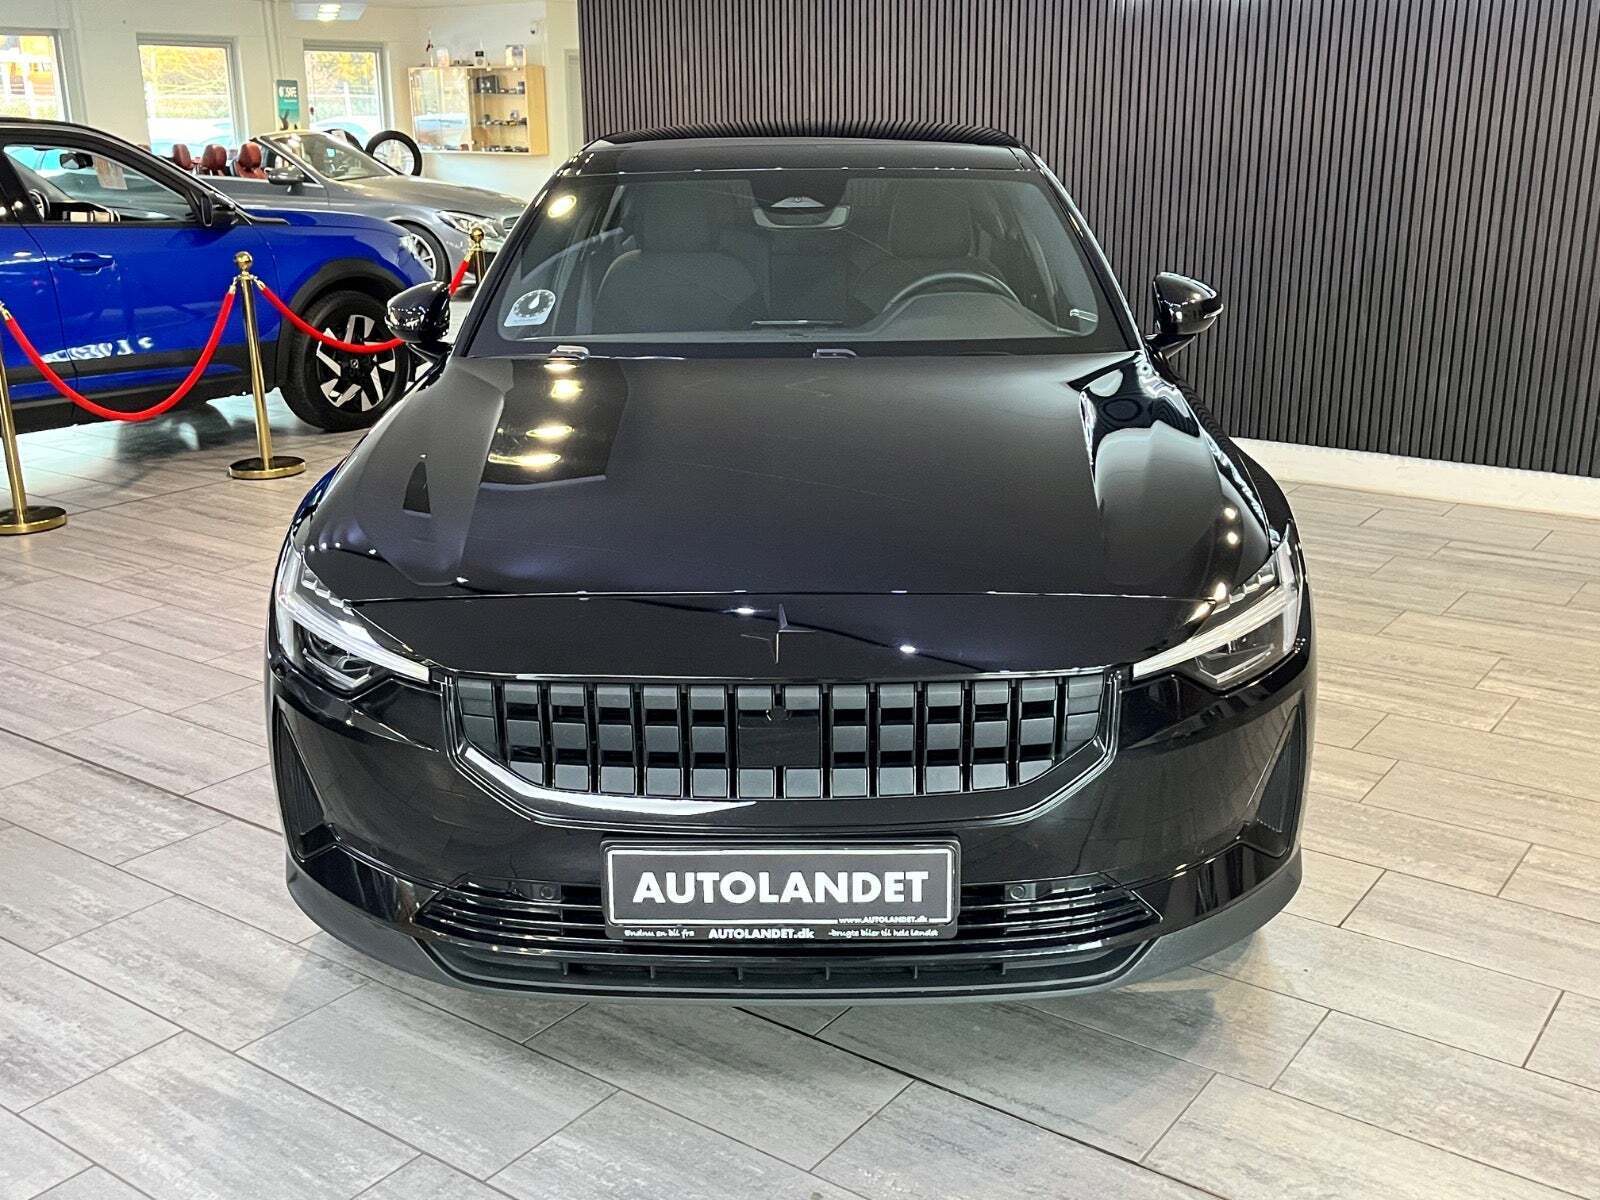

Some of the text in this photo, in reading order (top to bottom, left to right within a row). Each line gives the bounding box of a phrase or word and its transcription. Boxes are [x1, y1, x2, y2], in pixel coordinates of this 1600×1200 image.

[632, 871, 929, 903] AUTOLANDET
[838, 915, 928, 924] www.AUTOLANDET.dk
[668, 928, 680, 937] bil
[681, 929, 695, 939] fra
[708, 928, 815, 939] AUTOLANDET.dk
